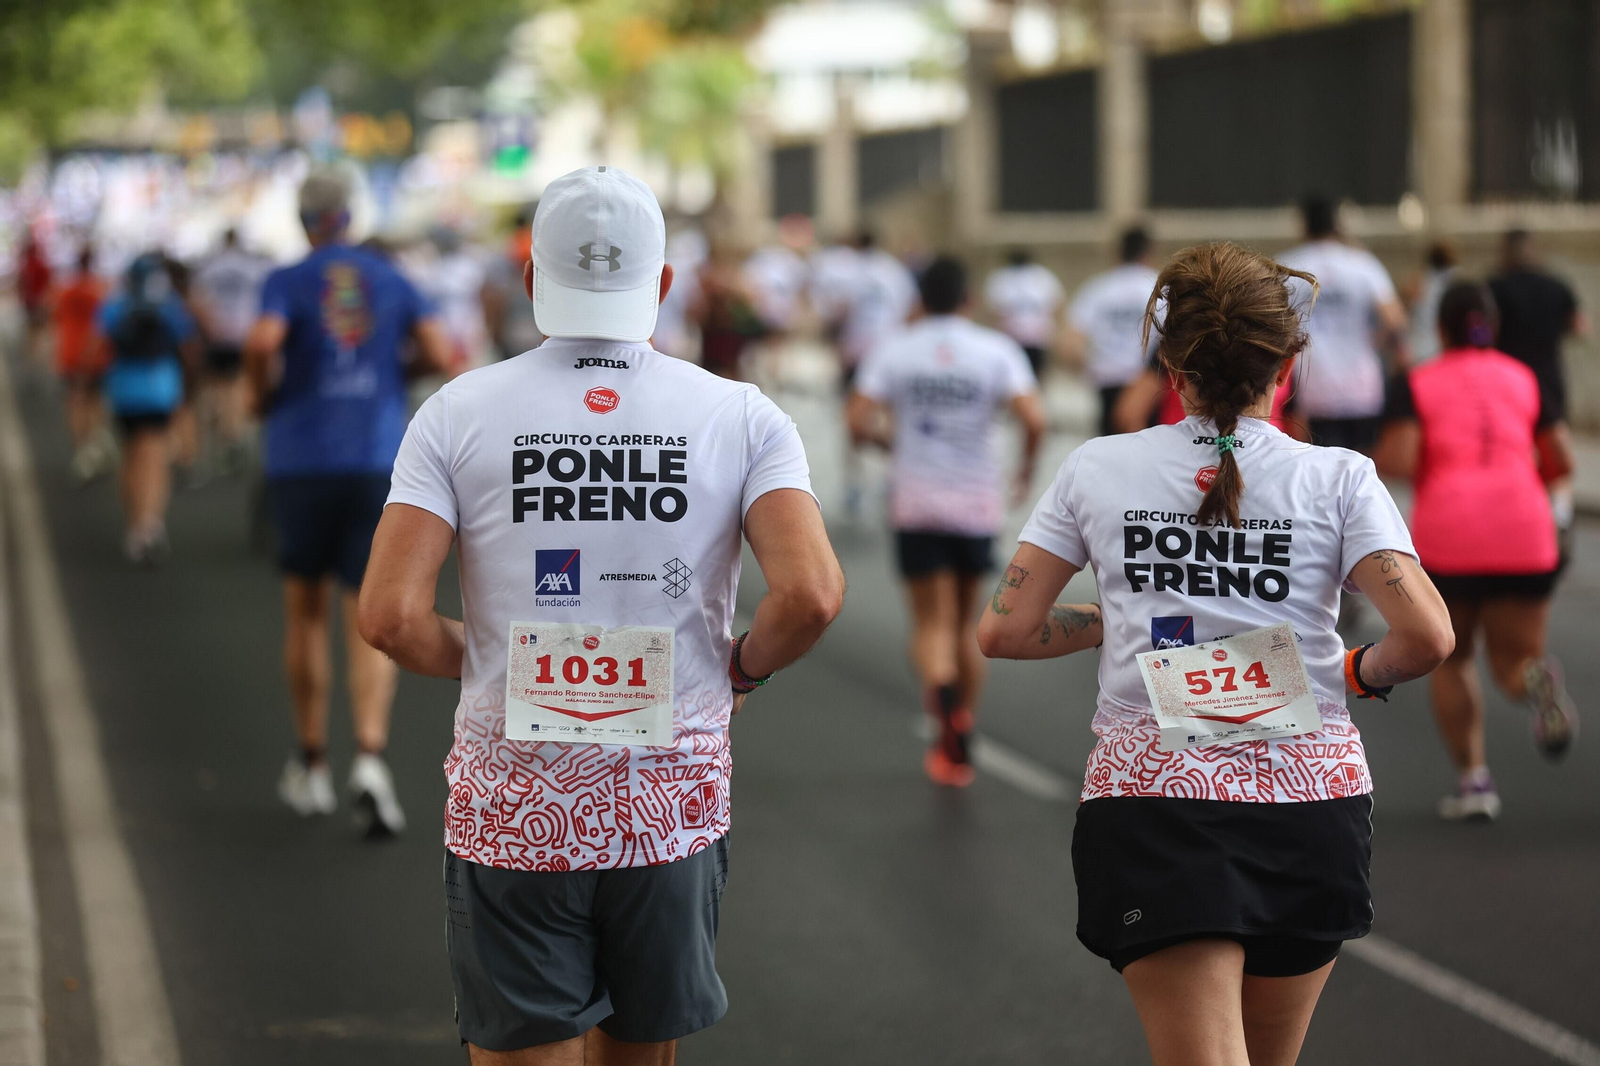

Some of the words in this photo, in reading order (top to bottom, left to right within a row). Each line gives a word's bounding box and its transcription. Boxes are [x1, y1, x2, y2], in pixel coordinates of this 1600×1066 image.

[588, 397, 614, 407] FRENO
[590, 392, 616, 402] PONLE
[513, 433, 592, 446] CIRCUITO
[595, 434, 688, 447] CARRERAS
[1192, 435, 1245, 448] Joa
[512, 448, 688, 484] PONLE
[512, 486, 688, 523] FRENO
[1124, 510, 1199, 526] CIRCUITO
[1123, 525, 1292, 567] PONLE
[535, 573, 573, 591] AXA
[599, 573, 657, 581] ATRESMEDIA
[1123, 562, 1290, 603] FRENO
[535, 597, 581, 607] fundación
[535, 654, 647, 687] 1031
[1184, 661, 1272, 696] 574
[524, 688, 563, 696] Fernando
[598, 691, 656, 700] Sanchez-Elipe
[1184, 699, 1221, 707] Mercedes
[1222, 695, 1254, 703] Jiménez
[1255, 690, 1286, 700] Jiménez
